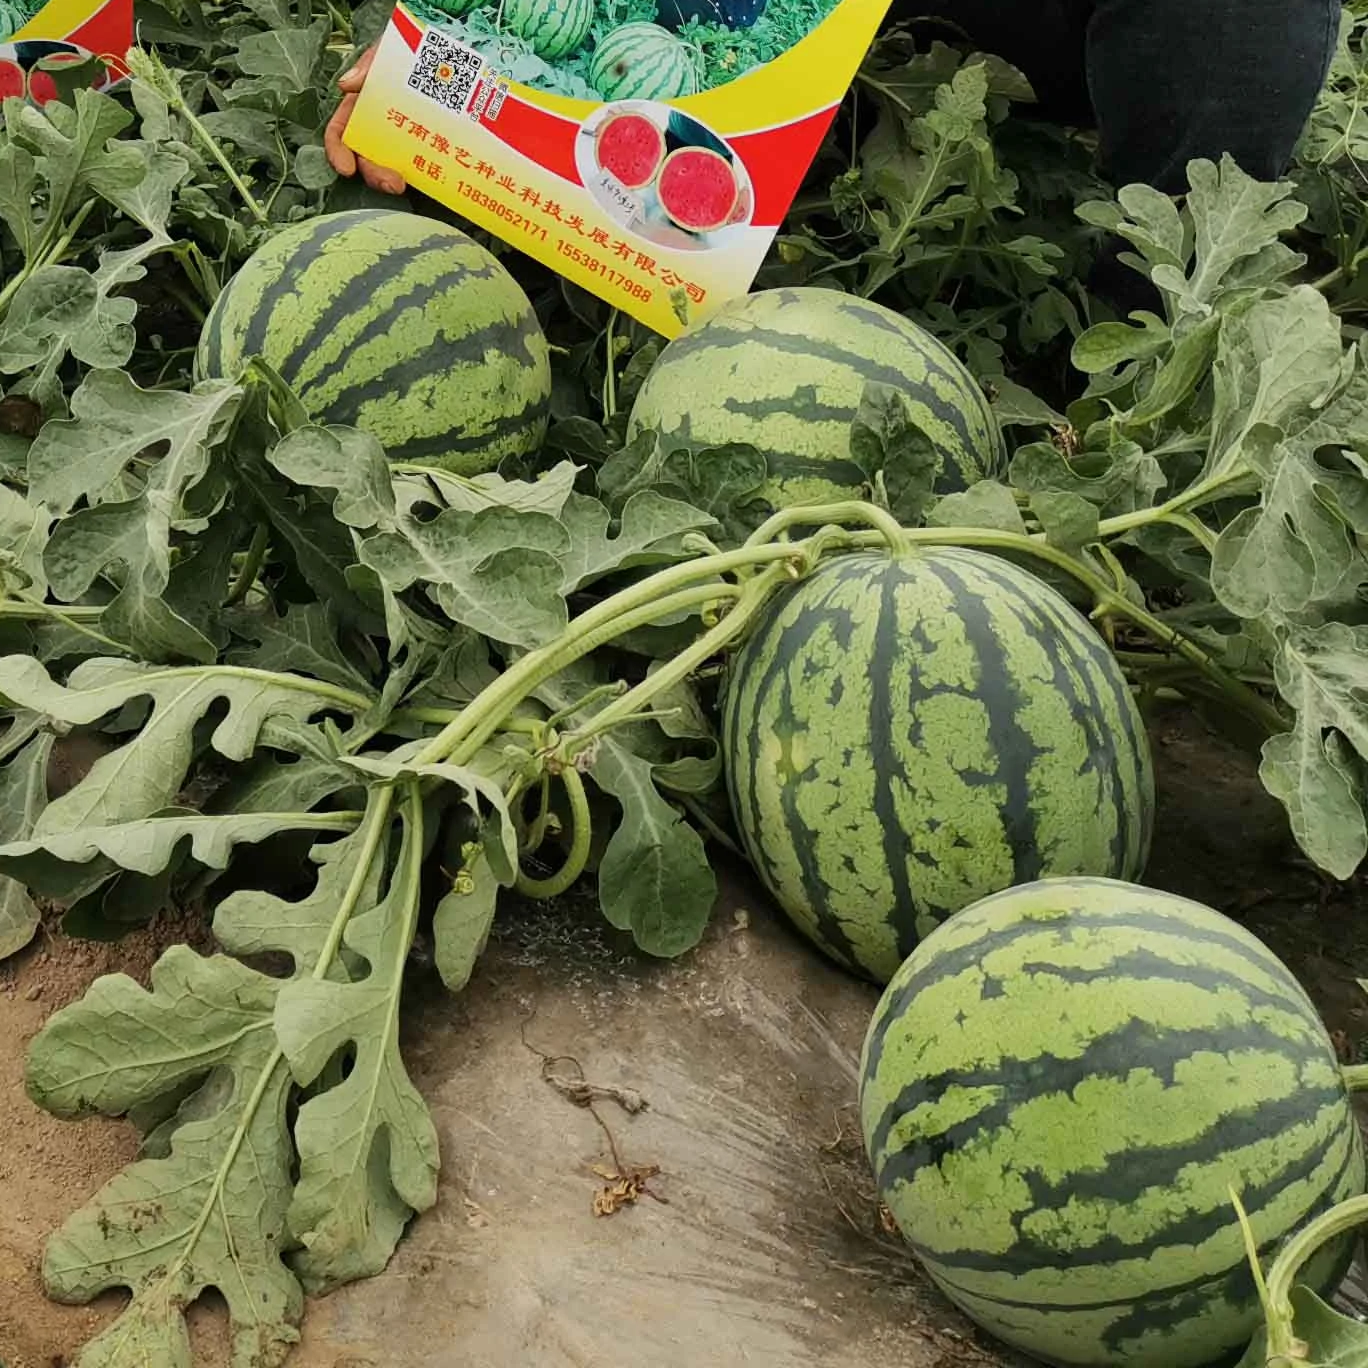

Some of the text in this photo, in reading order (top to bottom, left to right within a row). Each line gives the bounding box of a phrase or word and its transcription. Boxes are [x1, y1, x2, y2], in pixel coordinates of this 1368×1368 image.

[385, 108, 707, 305] 河南豫艺种业科技发展有限公司
[455, 179, 550, 243] 13838052171
[555, 238, 654, 304] 15538117988
